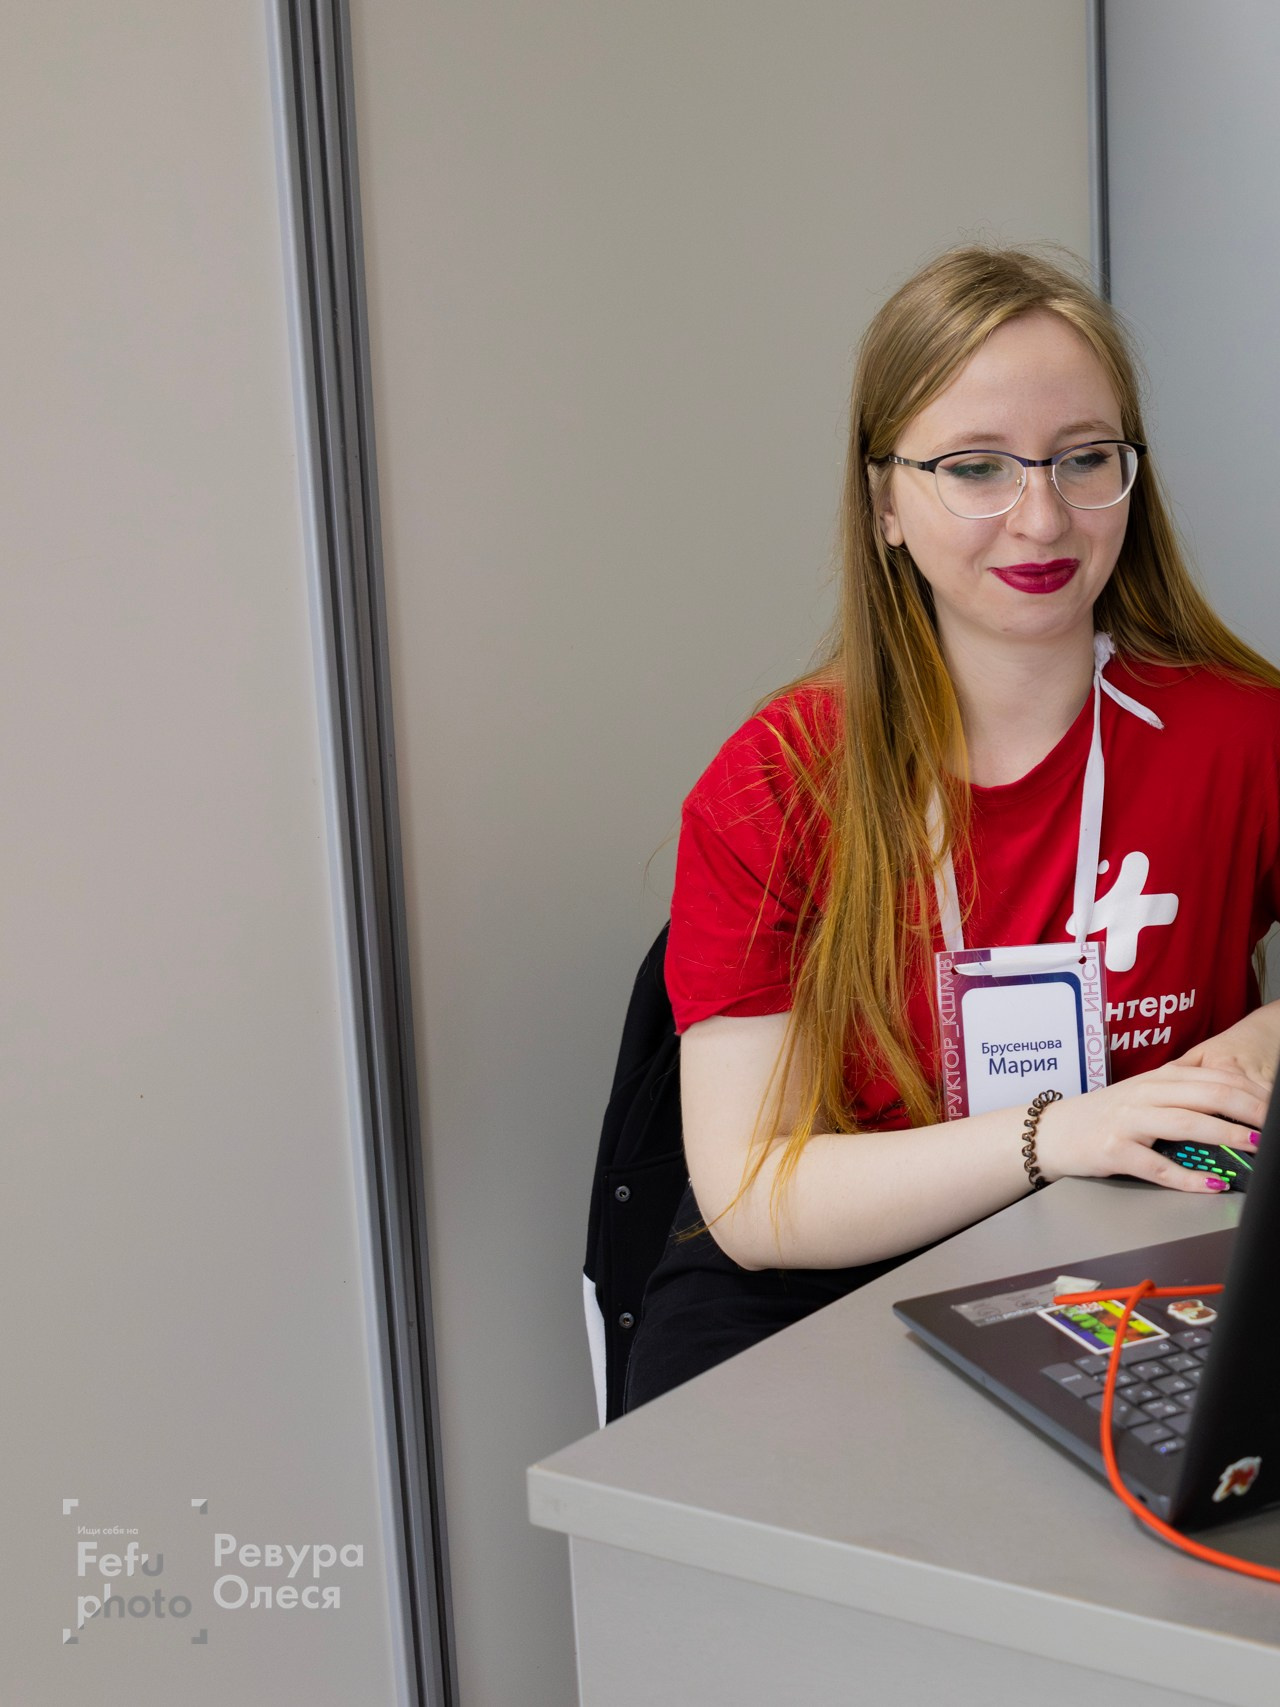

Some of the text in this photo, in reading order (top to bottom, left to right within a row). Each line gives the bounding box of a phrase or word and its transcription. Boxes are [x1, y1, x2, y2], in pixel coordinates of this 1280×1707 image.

[1105, 989, 1196, 1024] нтеры
[981, 1037, 1063, 1056] Брусенцова
[1106, 1026, 1172, 1051] ики
[988, 1055, 1058, 1077] Мария
